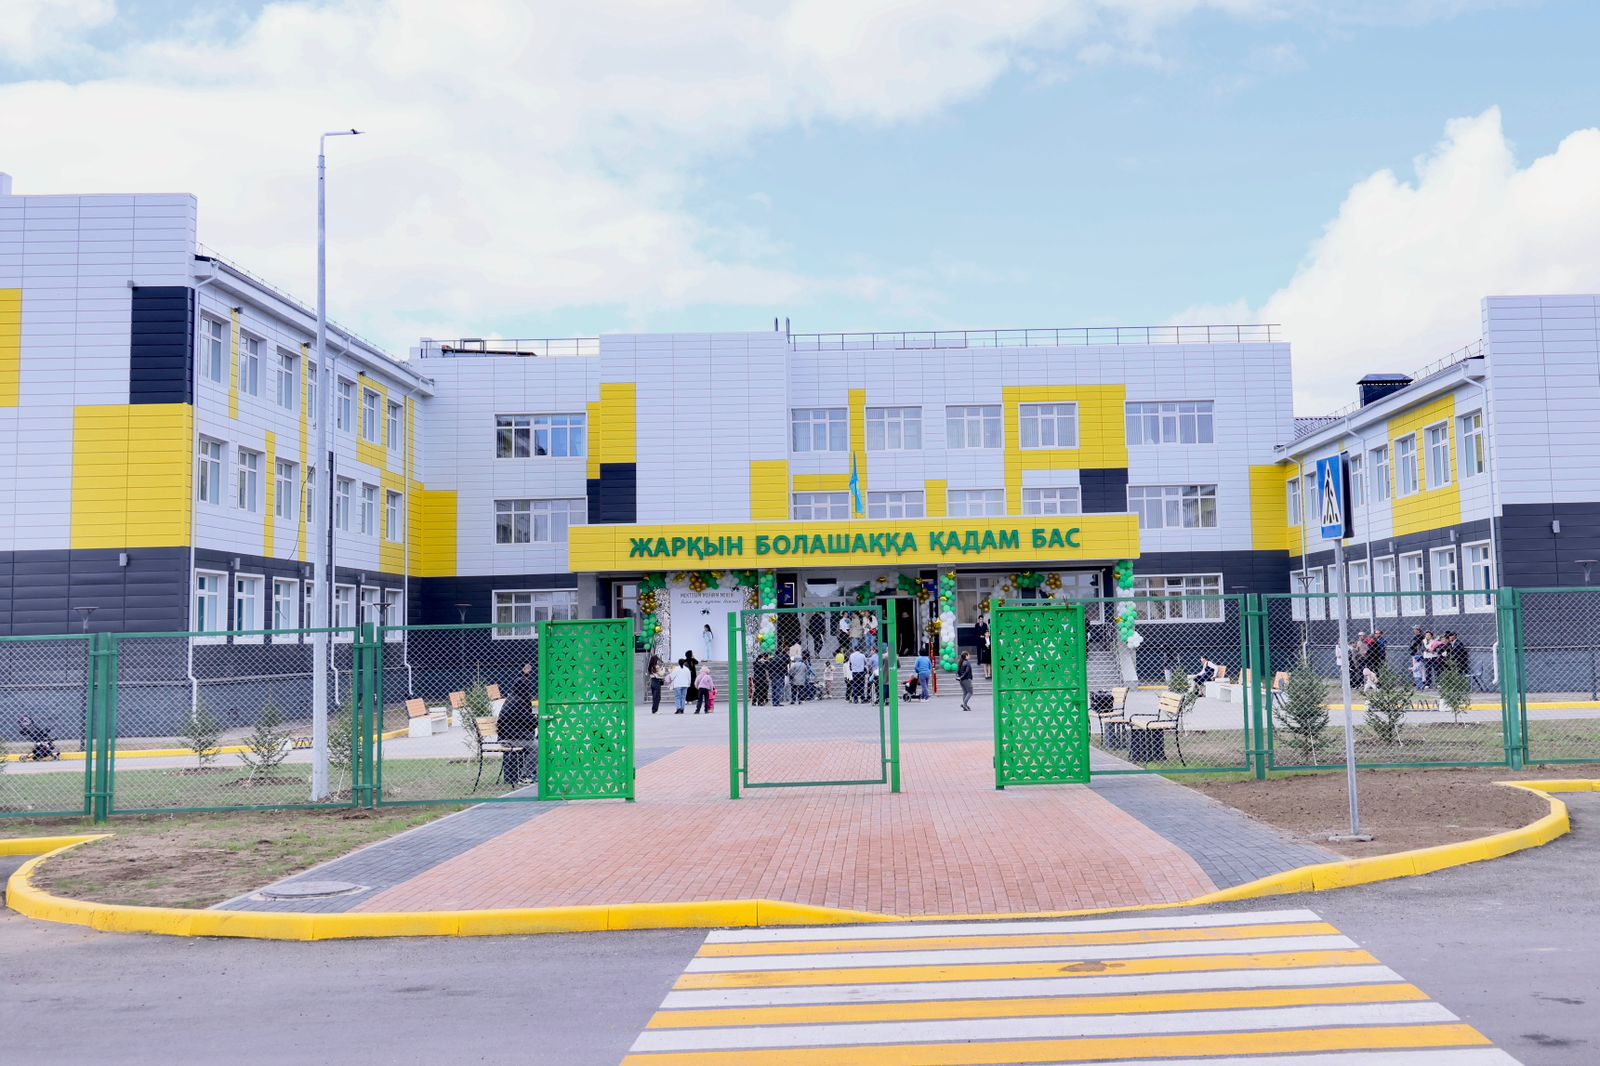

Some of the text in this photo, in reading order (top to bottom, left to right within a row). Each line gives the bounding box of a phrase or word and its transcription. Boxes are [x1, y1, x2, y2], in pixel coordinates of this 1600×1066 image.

[629, 527, 1081, 560] ЖАРҚЫН БОЛАШАҚҚА ҚАДАМ БАС
